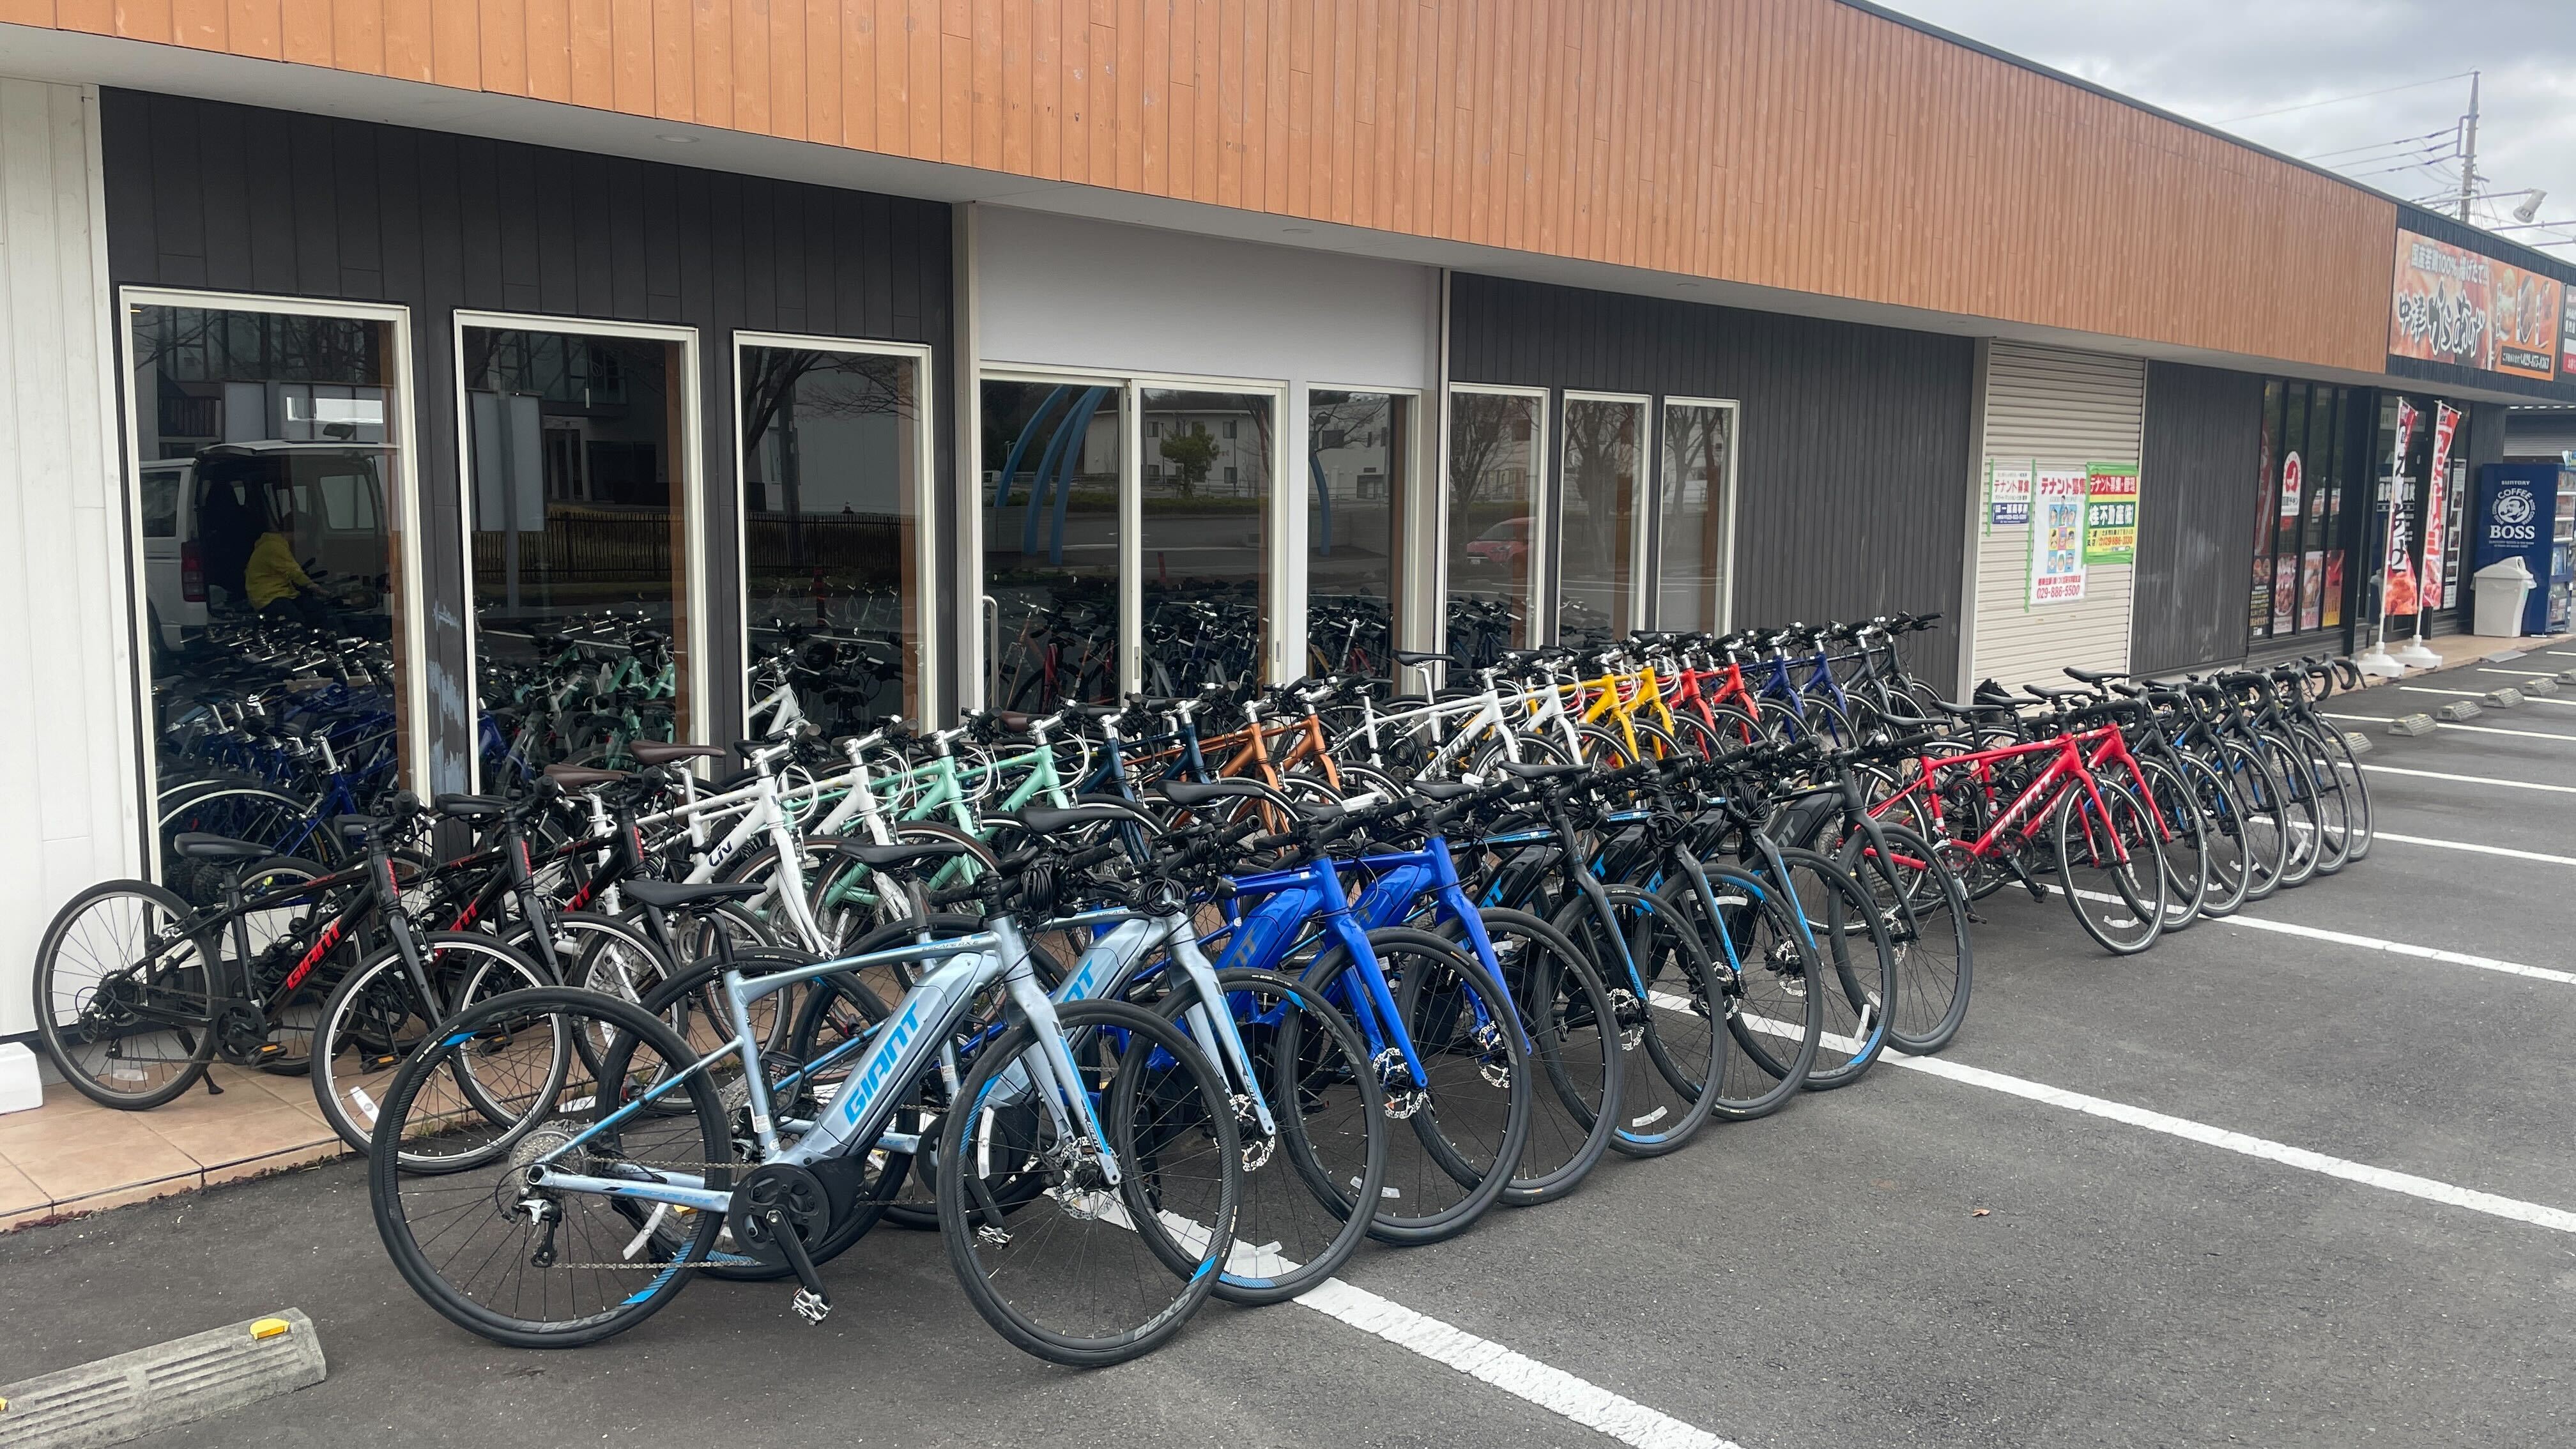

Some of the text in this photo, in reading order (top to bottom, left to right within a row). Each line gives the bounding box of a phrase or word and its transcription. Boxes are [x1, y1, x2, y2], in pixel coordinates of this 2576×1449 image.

[2497, 487, 2533, 500] COFFEE
[2489, 525, 2535, 539] BOSS
[1425, 728, 1469, 779] GIANT
[1991, 768, 2055, 841] GIANT
[286, 916, 342, 990] GIANT
[844, 999, 919, 1126] GIANT
